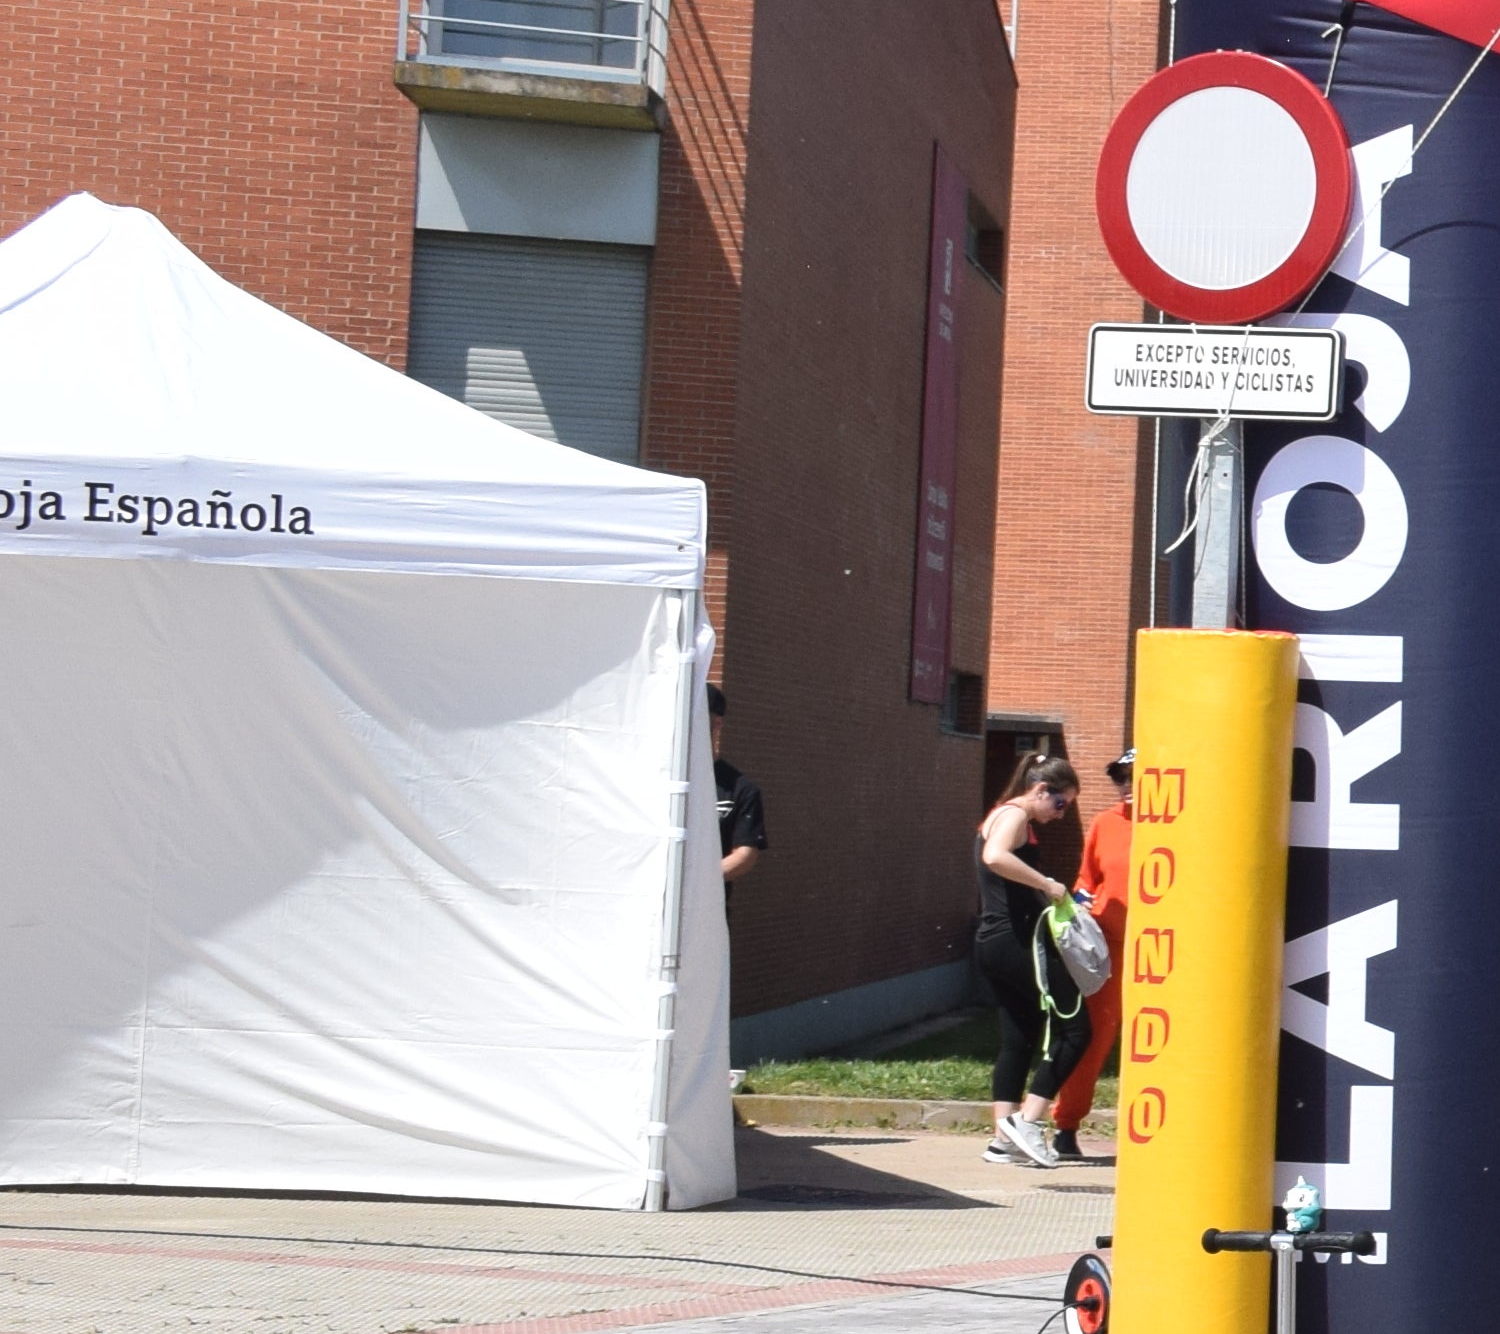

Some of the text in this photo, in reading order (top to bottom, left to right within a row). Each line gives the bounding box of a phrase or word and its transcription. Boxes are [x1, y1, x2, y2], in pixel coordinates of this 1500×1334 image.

[1114, 368, 1315, 393] UNIVERSIDAD Y CICLISTAS
[1136, 343, 1295, 369] EXCEPTO SERVICIOS,
[83, 481, 315, 536] Española
[1127, 765, 1186, 1146] MONDO
[1276, 900, 1398, 1210] LA
